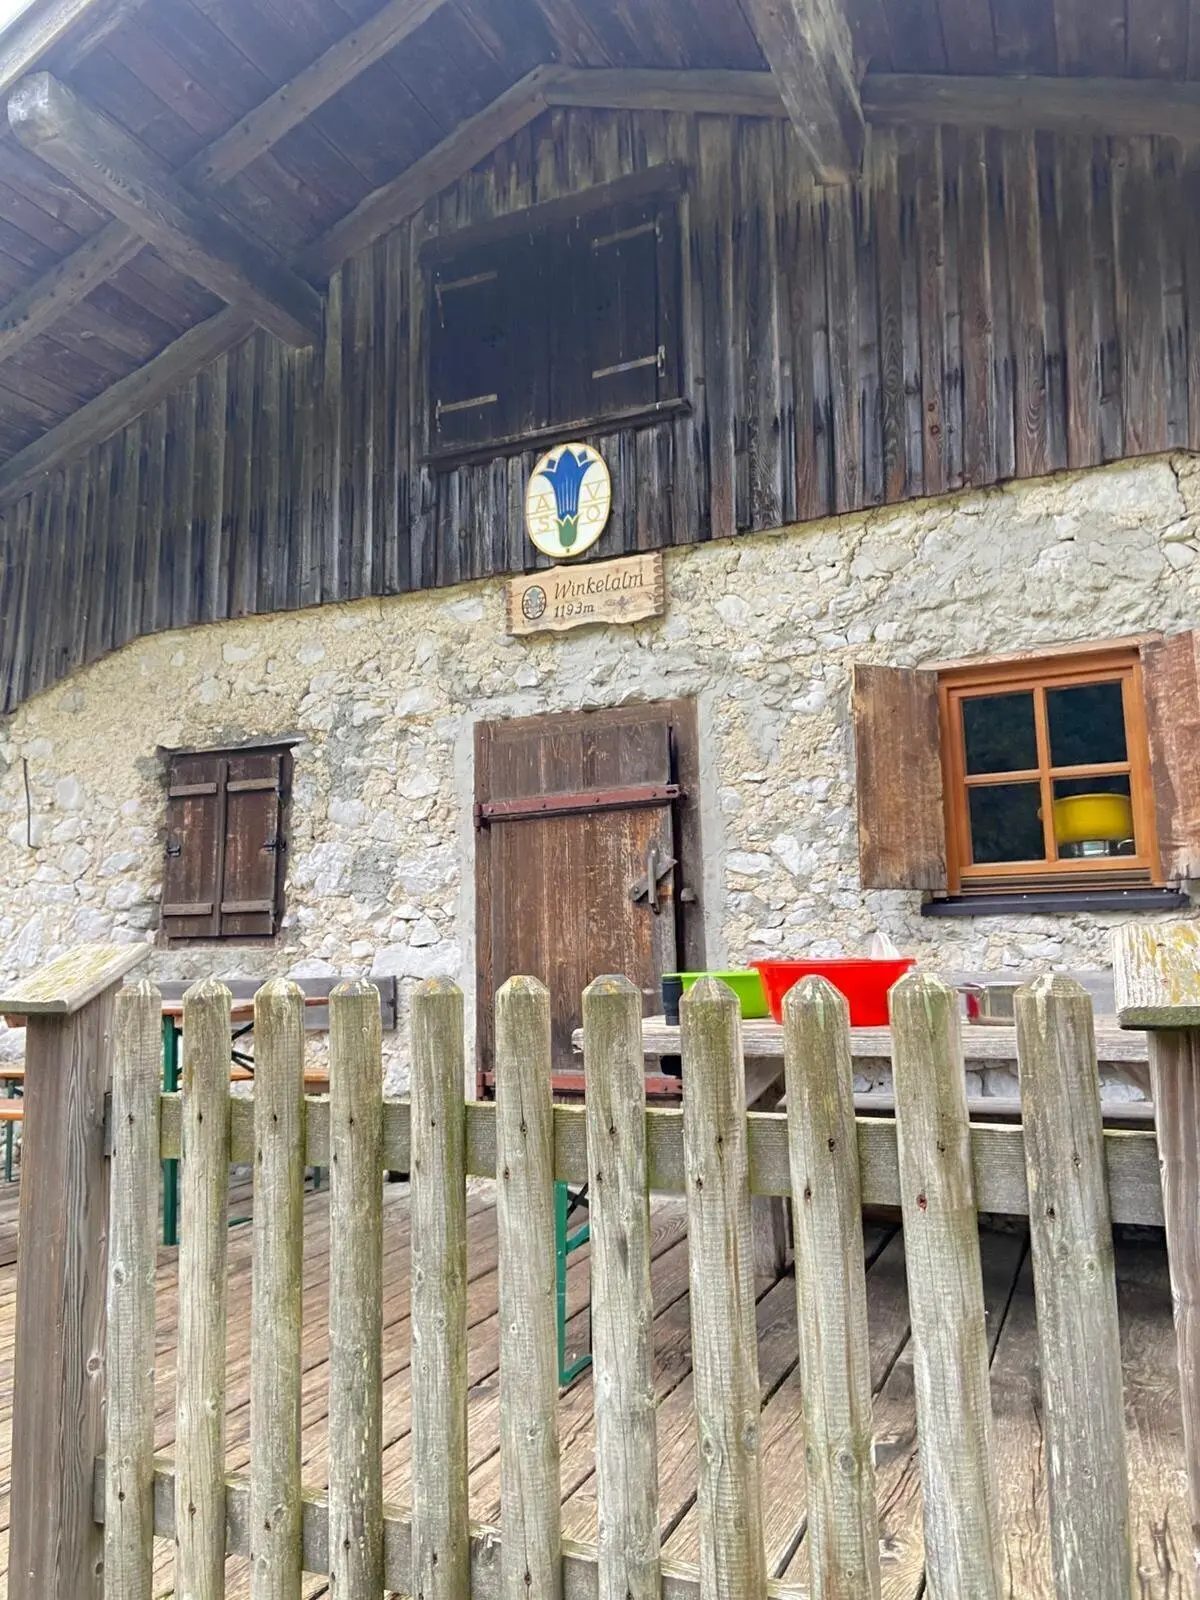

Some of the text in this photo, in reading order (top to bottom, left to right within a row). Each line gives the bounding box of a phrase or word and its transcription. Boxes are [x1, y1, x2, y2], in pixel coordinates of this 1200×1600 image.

[536, 484, 600, 513] A V
[555, 571, 643, 599] Winkelalm
[554, 602, 594, 618] 1193m
